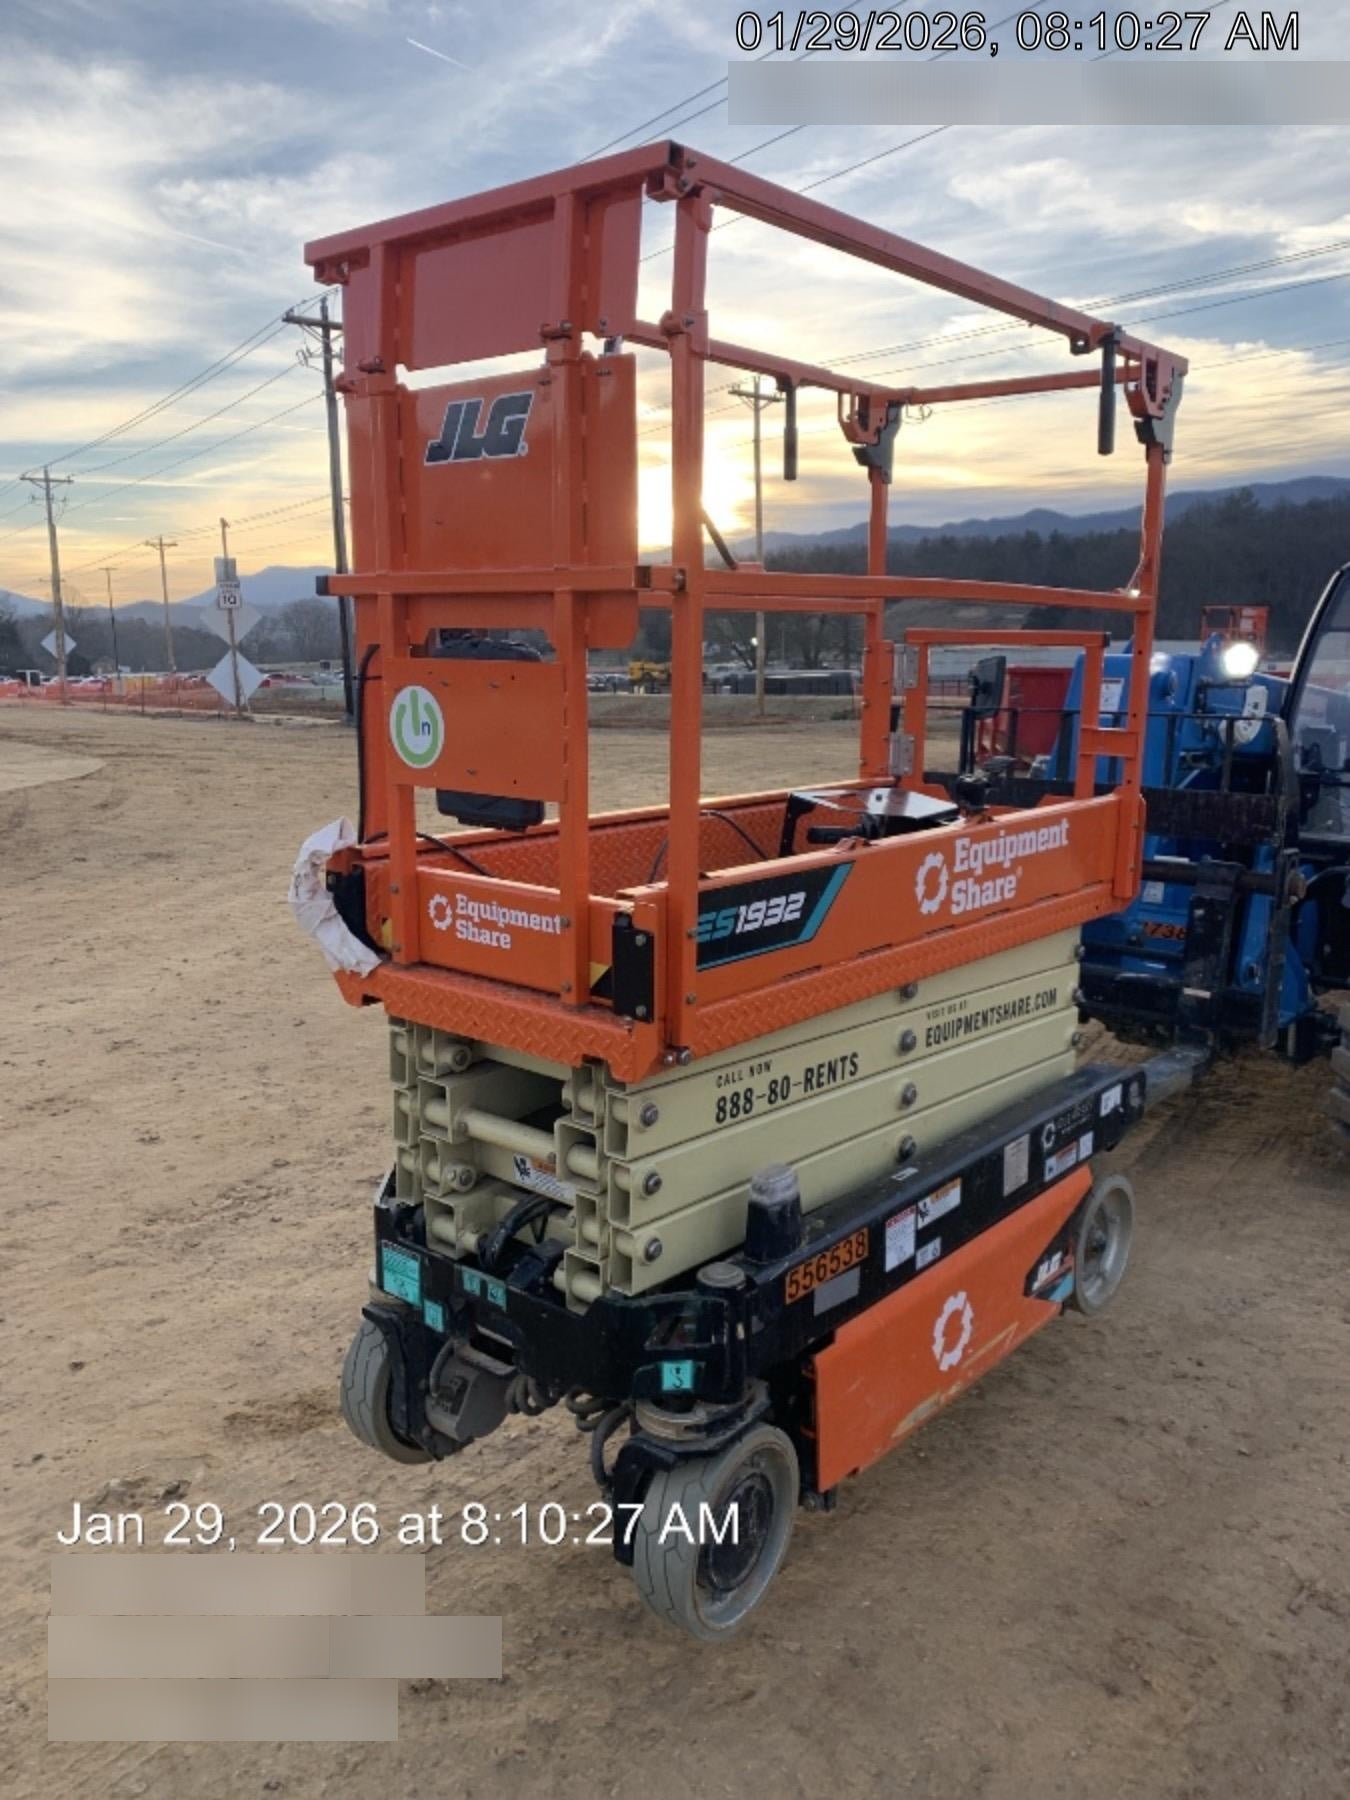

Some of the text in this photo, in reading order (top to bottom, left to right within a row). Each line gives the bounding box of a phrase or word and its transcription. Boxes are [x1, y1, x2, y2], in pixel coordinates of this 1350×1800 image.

[423, 389, 535, 467] JLG
[953, 817, 1070, 877] Equipment
[455, 892, 562, 935] Equipment
[951, 872, 1018, 916] Share
[455, 918, 512, 950] Share
[925, 987, 1058, 1049] EQUIPMENTSHARE.COM
[714, 1051, 860, 1125] 888-80-RENTS
[715, 1058, 774, 1089] CALL NOW
[787, 1231, 866, 1300] 556538
